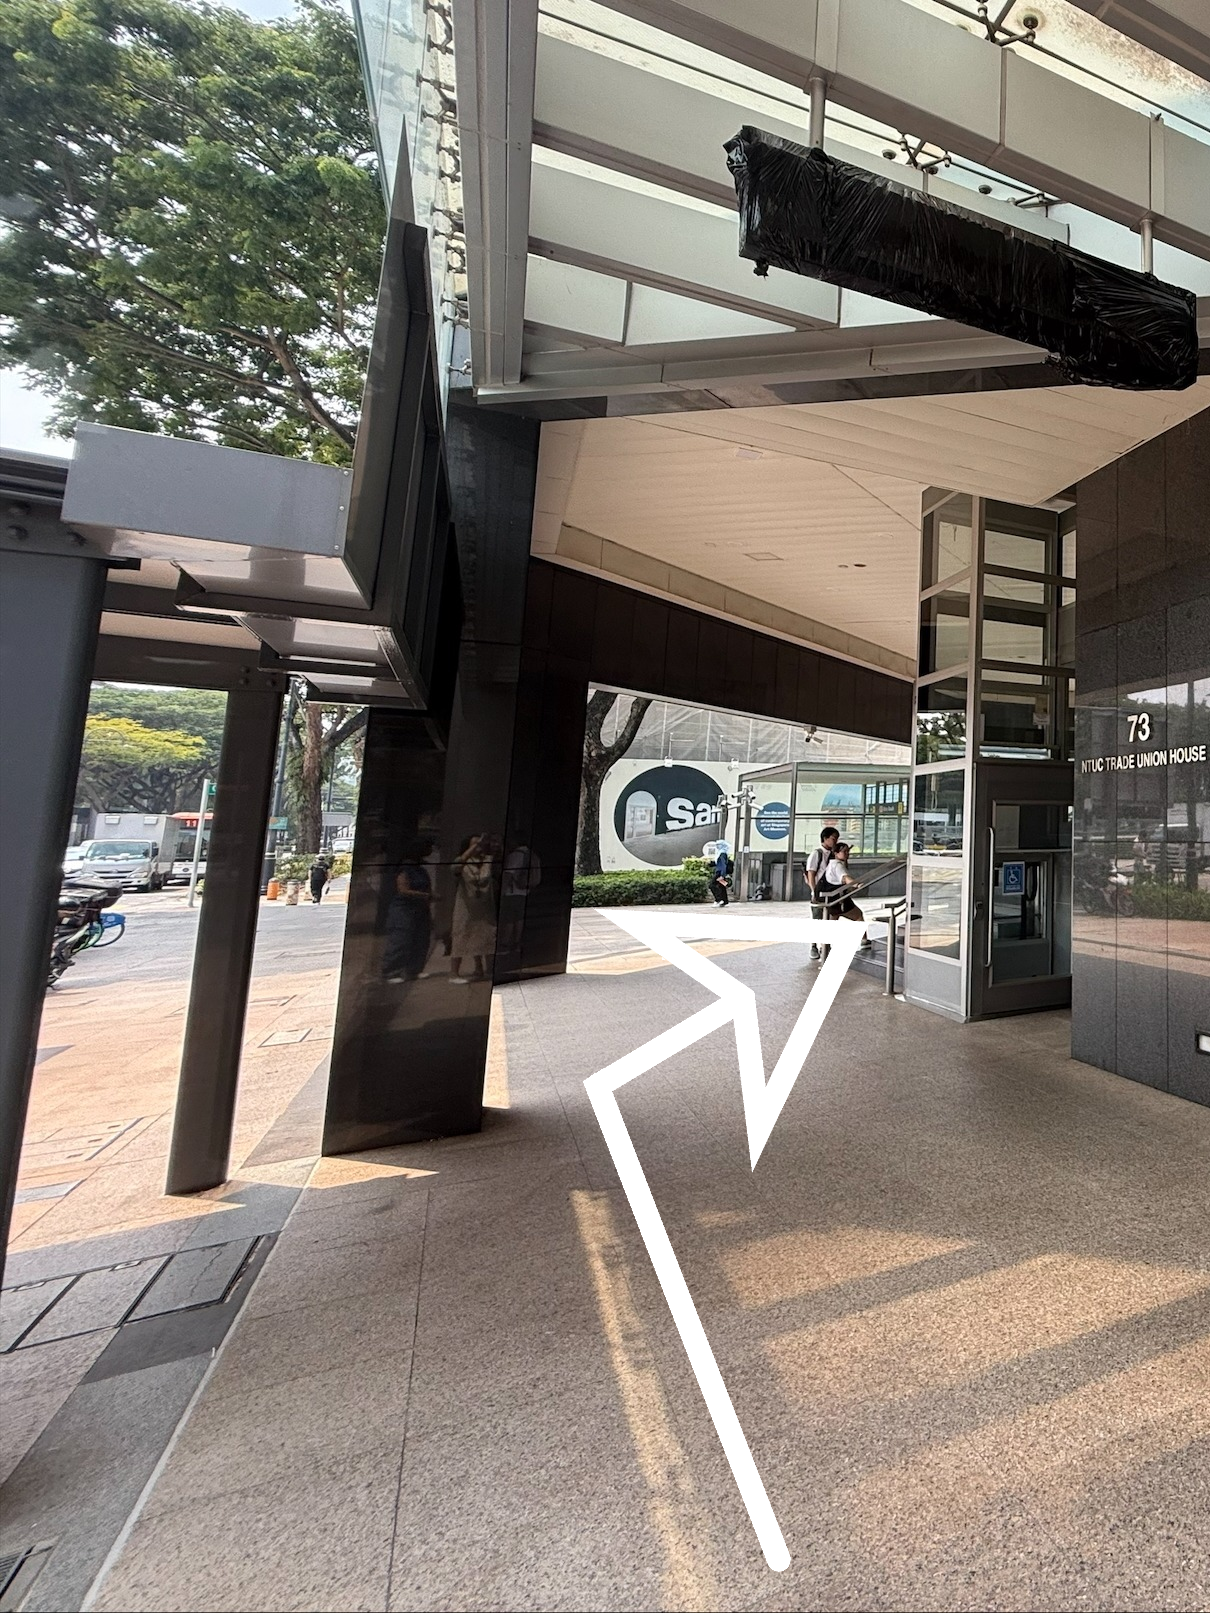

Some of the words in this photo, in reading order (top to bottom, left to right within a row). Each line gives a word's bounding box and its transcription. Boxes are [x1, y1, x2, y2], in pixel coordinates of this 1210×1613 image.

[1127, 712, 1150, 742] 73
[1081, 757, 1104, 773] NTUC
[1105, 754, 1135, 771] TRADE
[1136, 750, 1167, 768] UNION
[1169, 745, 1207, 764] HOUSE
